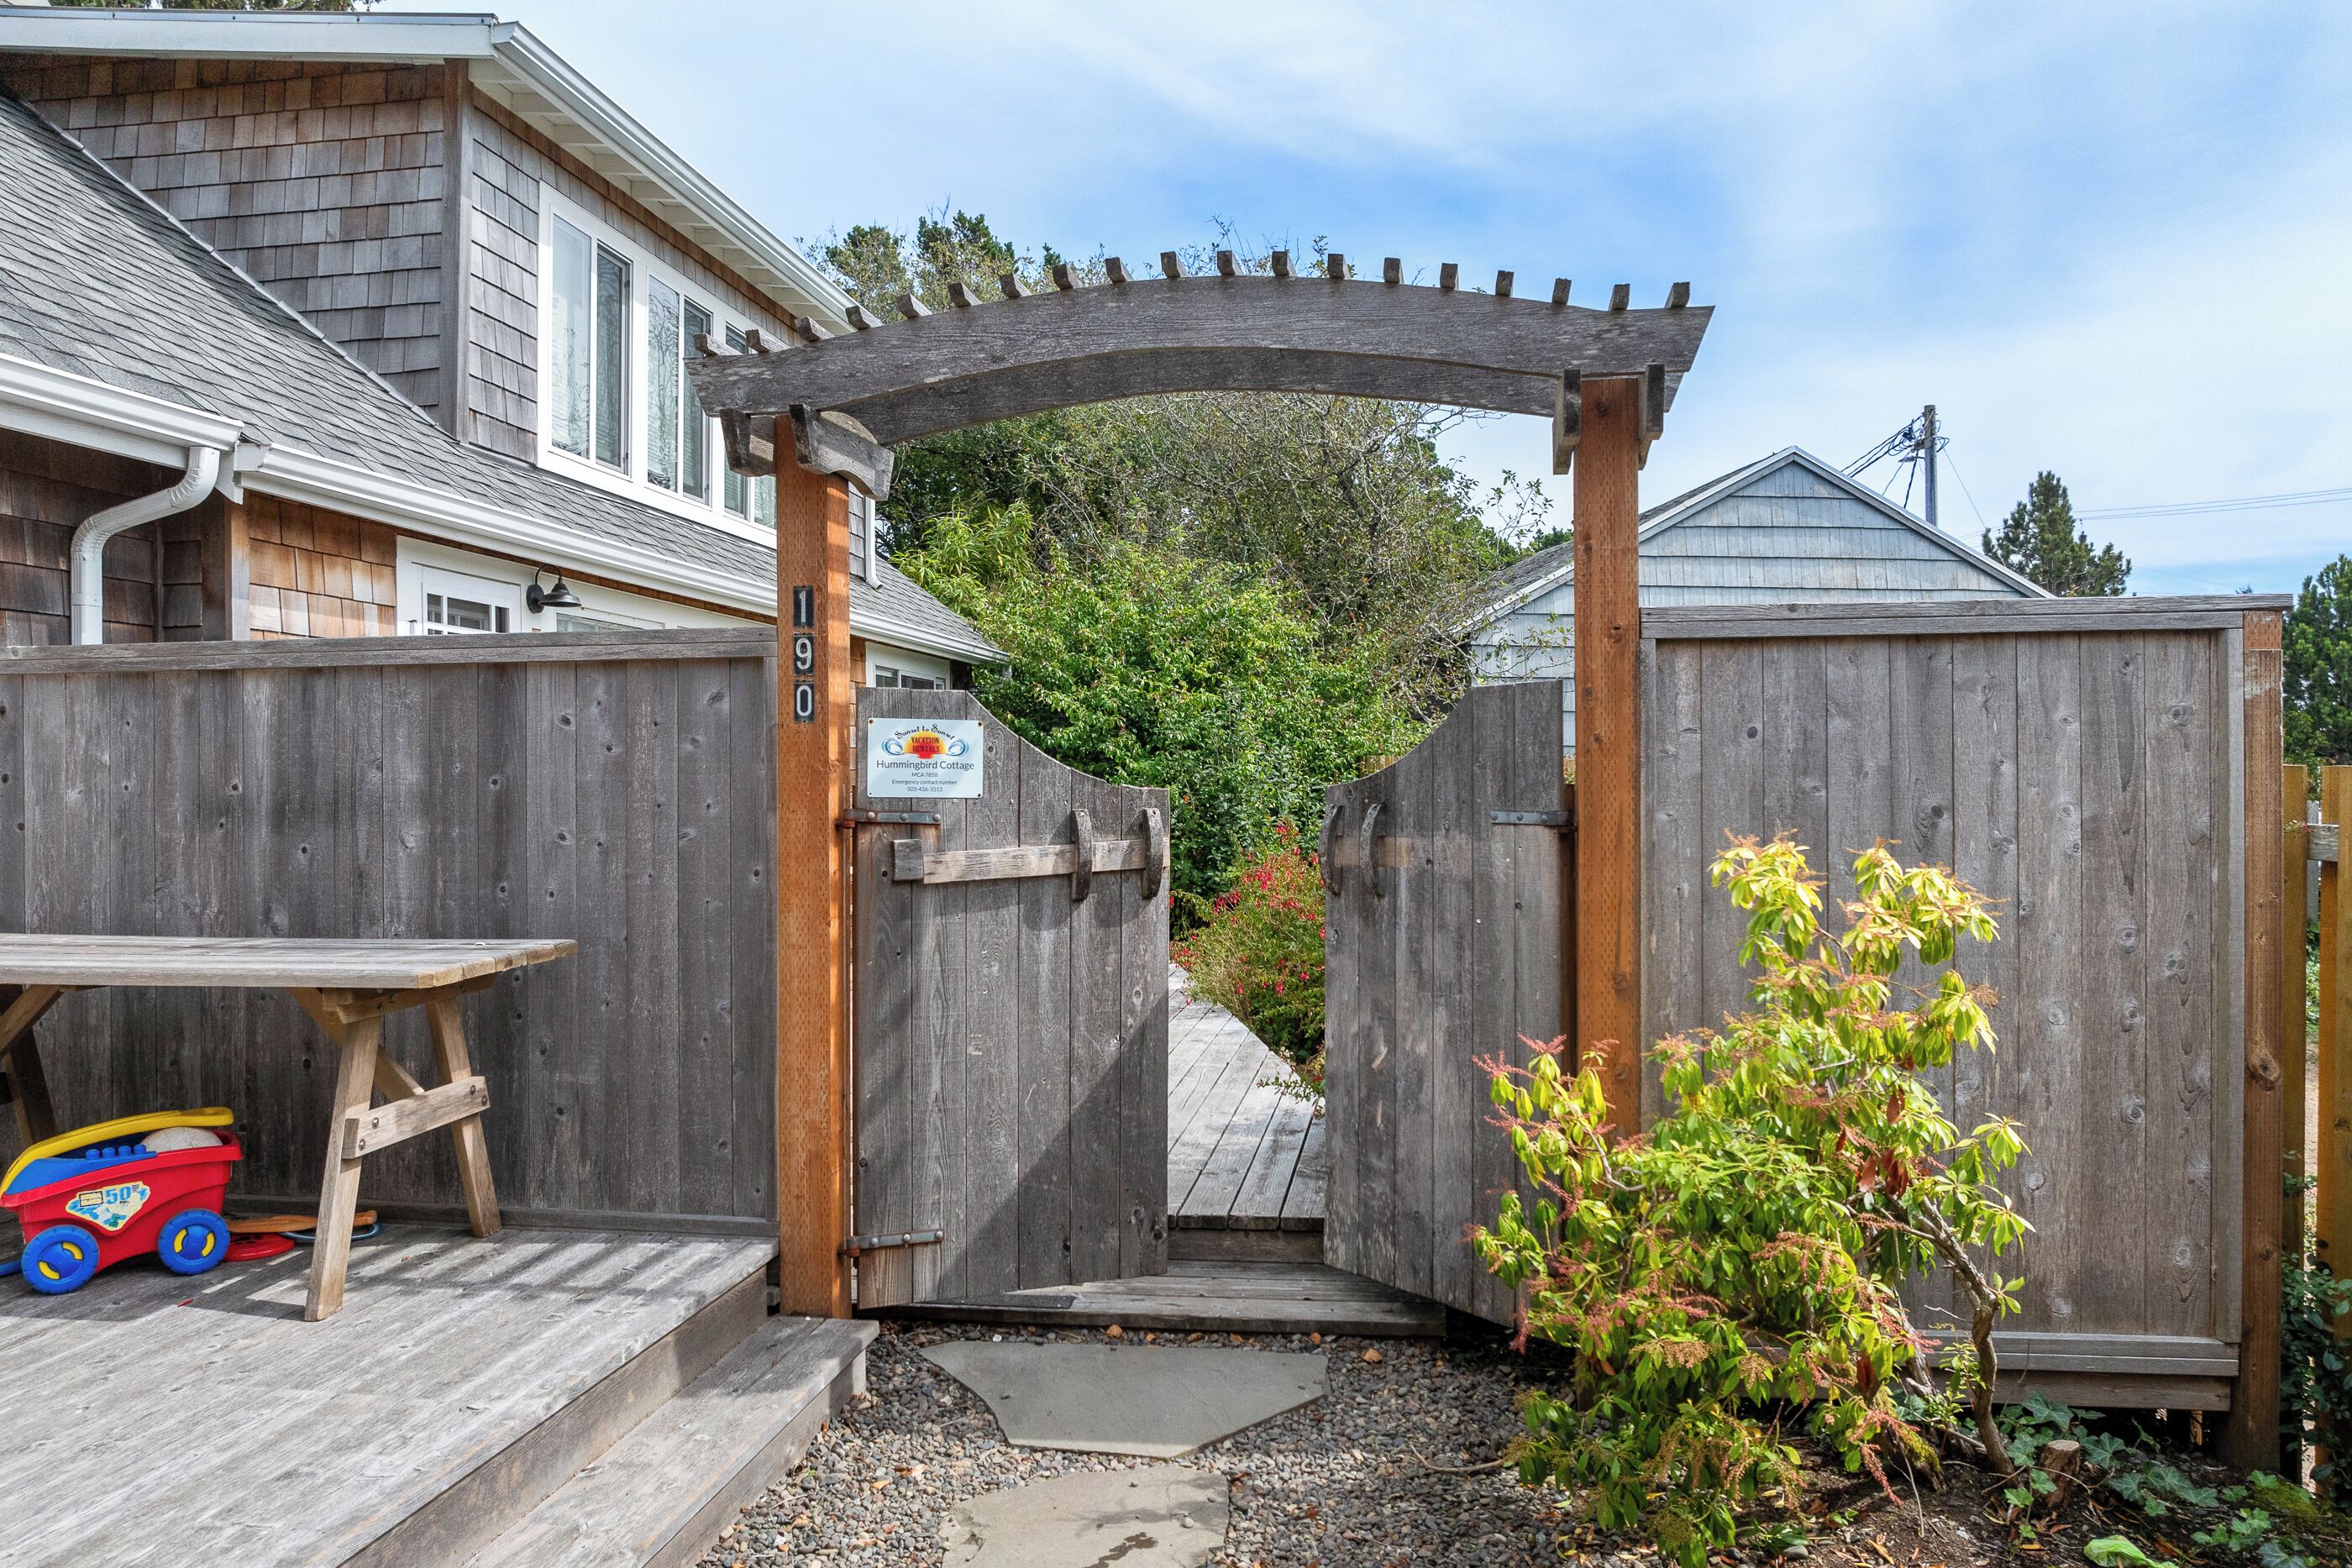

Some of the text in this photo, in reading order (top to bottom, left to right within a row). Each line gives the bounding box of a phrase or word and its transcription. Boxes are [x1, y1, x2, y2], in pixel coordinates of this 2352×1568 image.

[795, 590, 812, 716] 190
[895, 726, 920, 740] Sunset
[932, 724, 955, 740] Sunset
[876, 760, 974, 771] Hummingbird Cottage
[105, 1186, 131, 1204] 50
